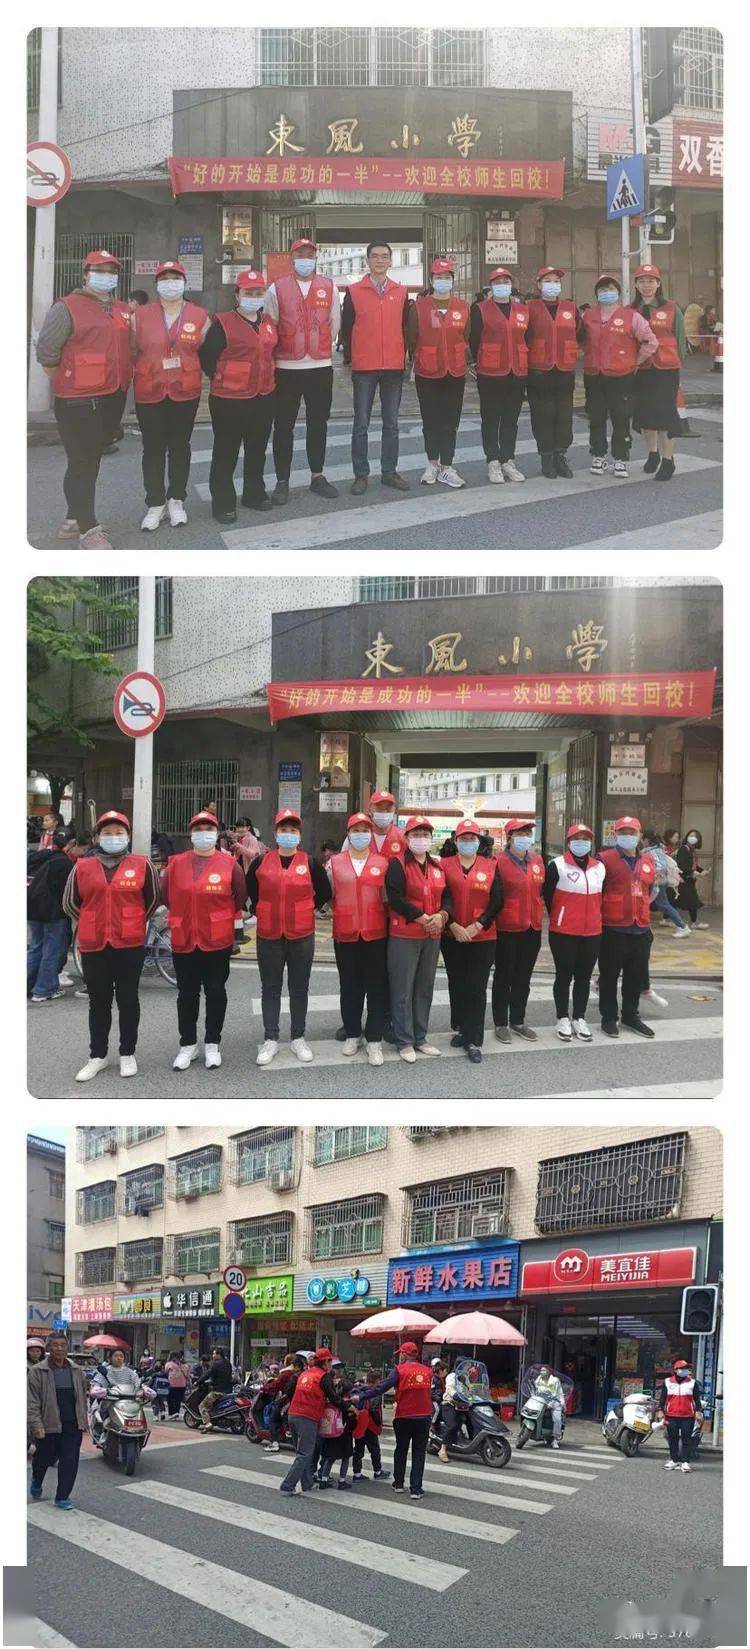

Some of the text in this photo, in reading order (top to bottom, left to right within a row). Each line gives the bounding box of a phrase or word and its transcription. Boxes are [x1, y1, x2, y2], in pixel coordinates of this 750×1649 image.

[266, 113, 481, 159] 東風小學
[361, 620, 609, 679] 東風小學
[229, 1271, 243, 1286] 20
[392, 1256, 513, 1294] 新鲜水果店
[600, 1256, 651, 1274] 美宜佳
[176, 1289, 213, 1308] 华信通
